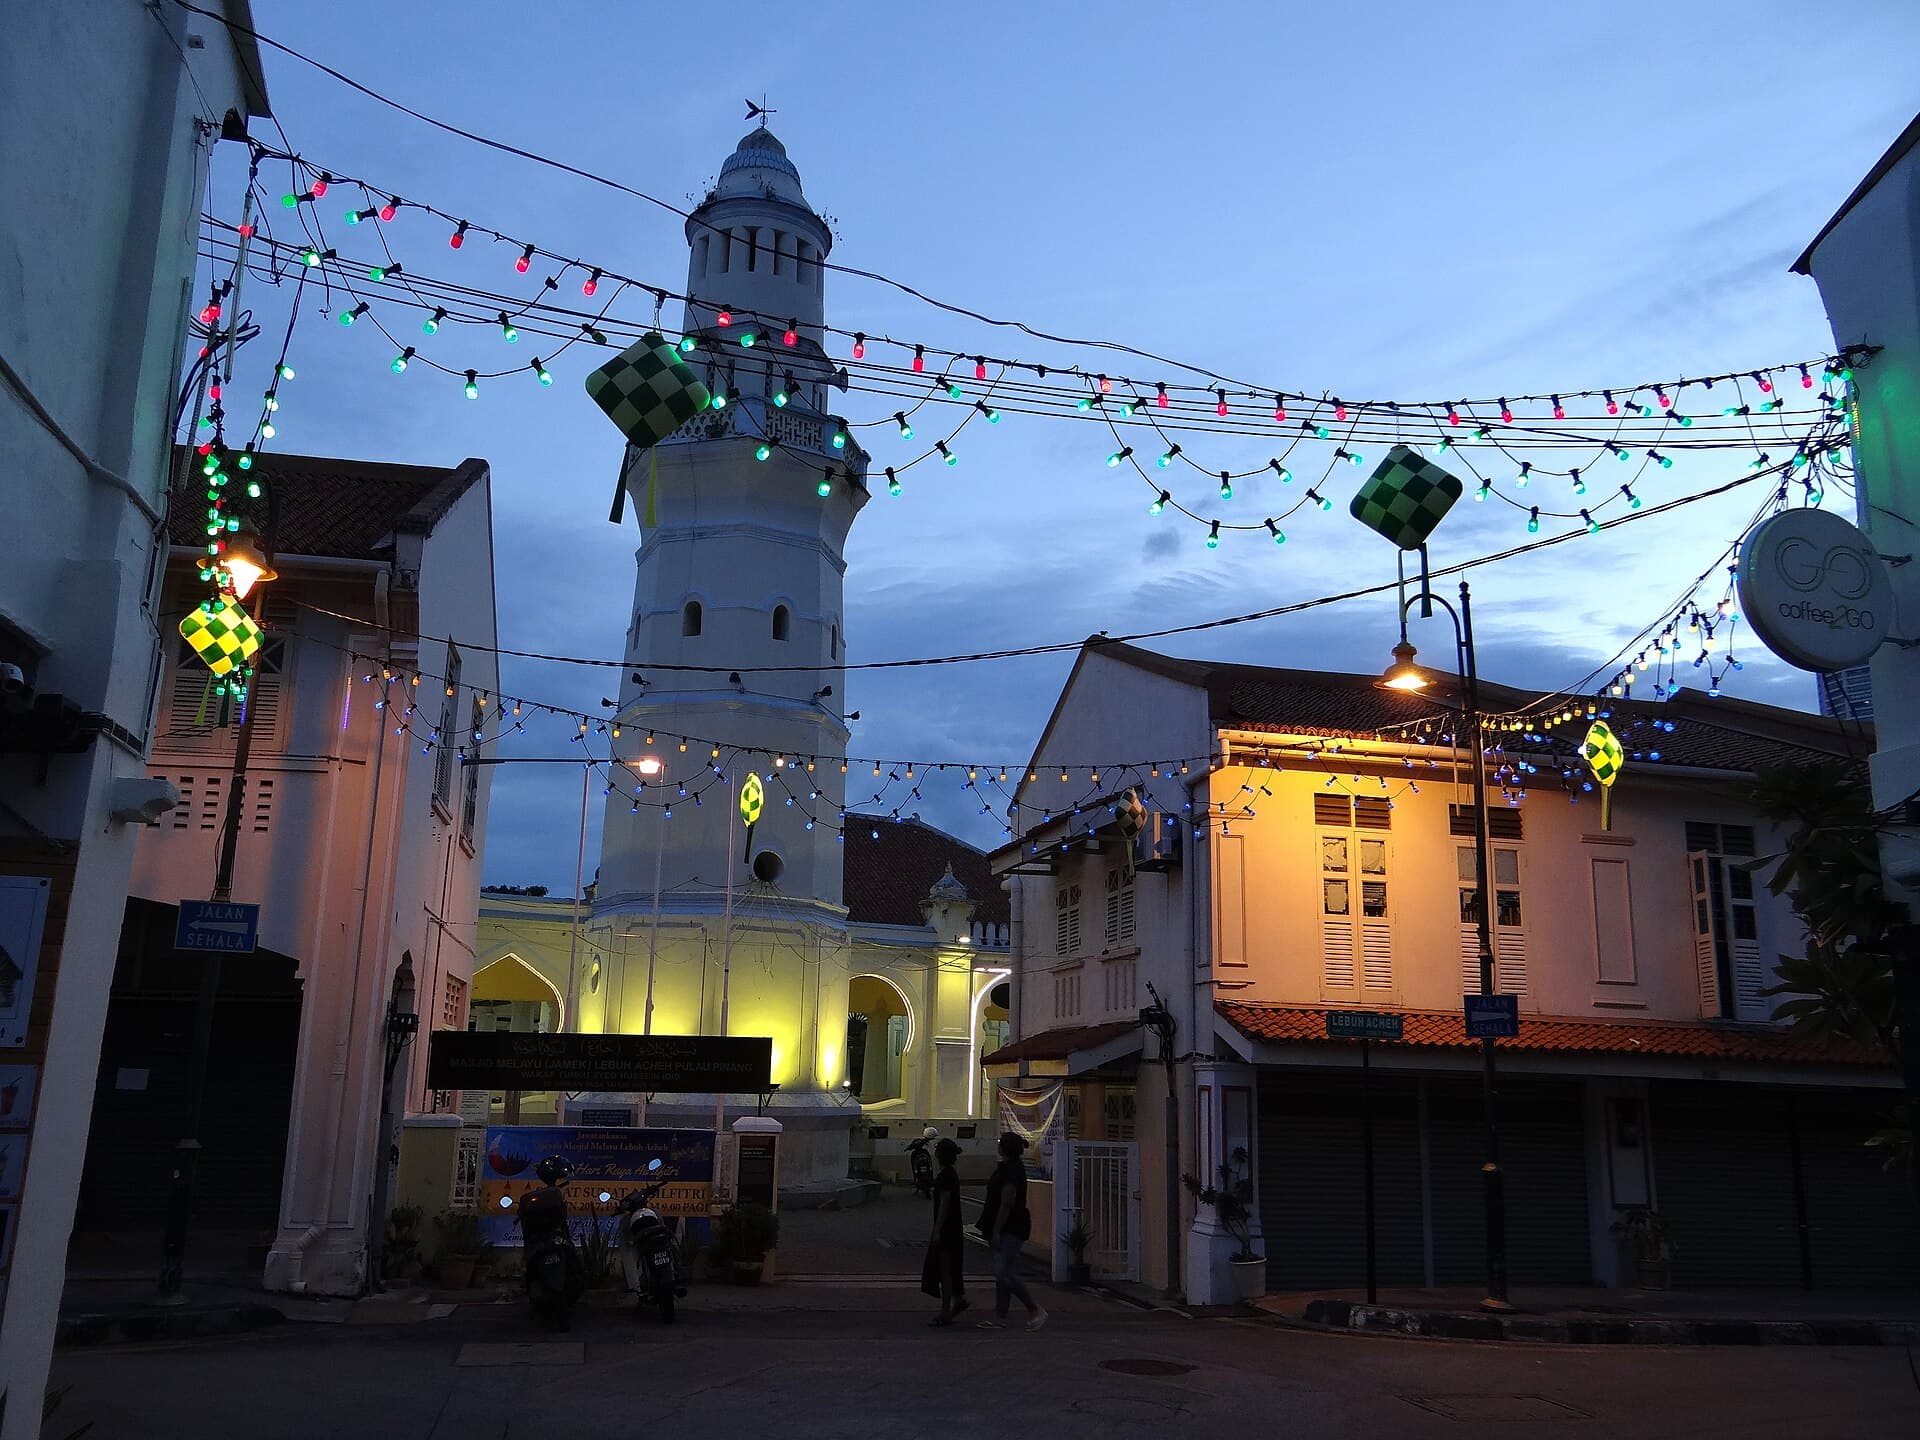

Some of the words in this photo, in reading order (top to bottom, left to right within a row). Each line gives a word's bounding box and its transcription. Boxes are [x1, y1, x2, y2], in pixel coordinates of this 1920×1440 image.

[1779, 601, 1875, 630] coffee2GO
[195, 904, 245, 920] JALAN
[186, 933, 245, 949] SEHALA
[1473, 999, 1507, 1009] JALAN
[1332, 1015, 1364, 1028] LEBUH
[1365, 1016, 1399, 1029] ACHEH
[496, 1059, 542, 1069] MELAYU
[594, 1060, 631, 1070] LEBUH
[634, 1060, 672, 1071] ACHEH
[674, 1061, 709, 1071] PULAU
[712, 1062, 753, 1072] PINANG
